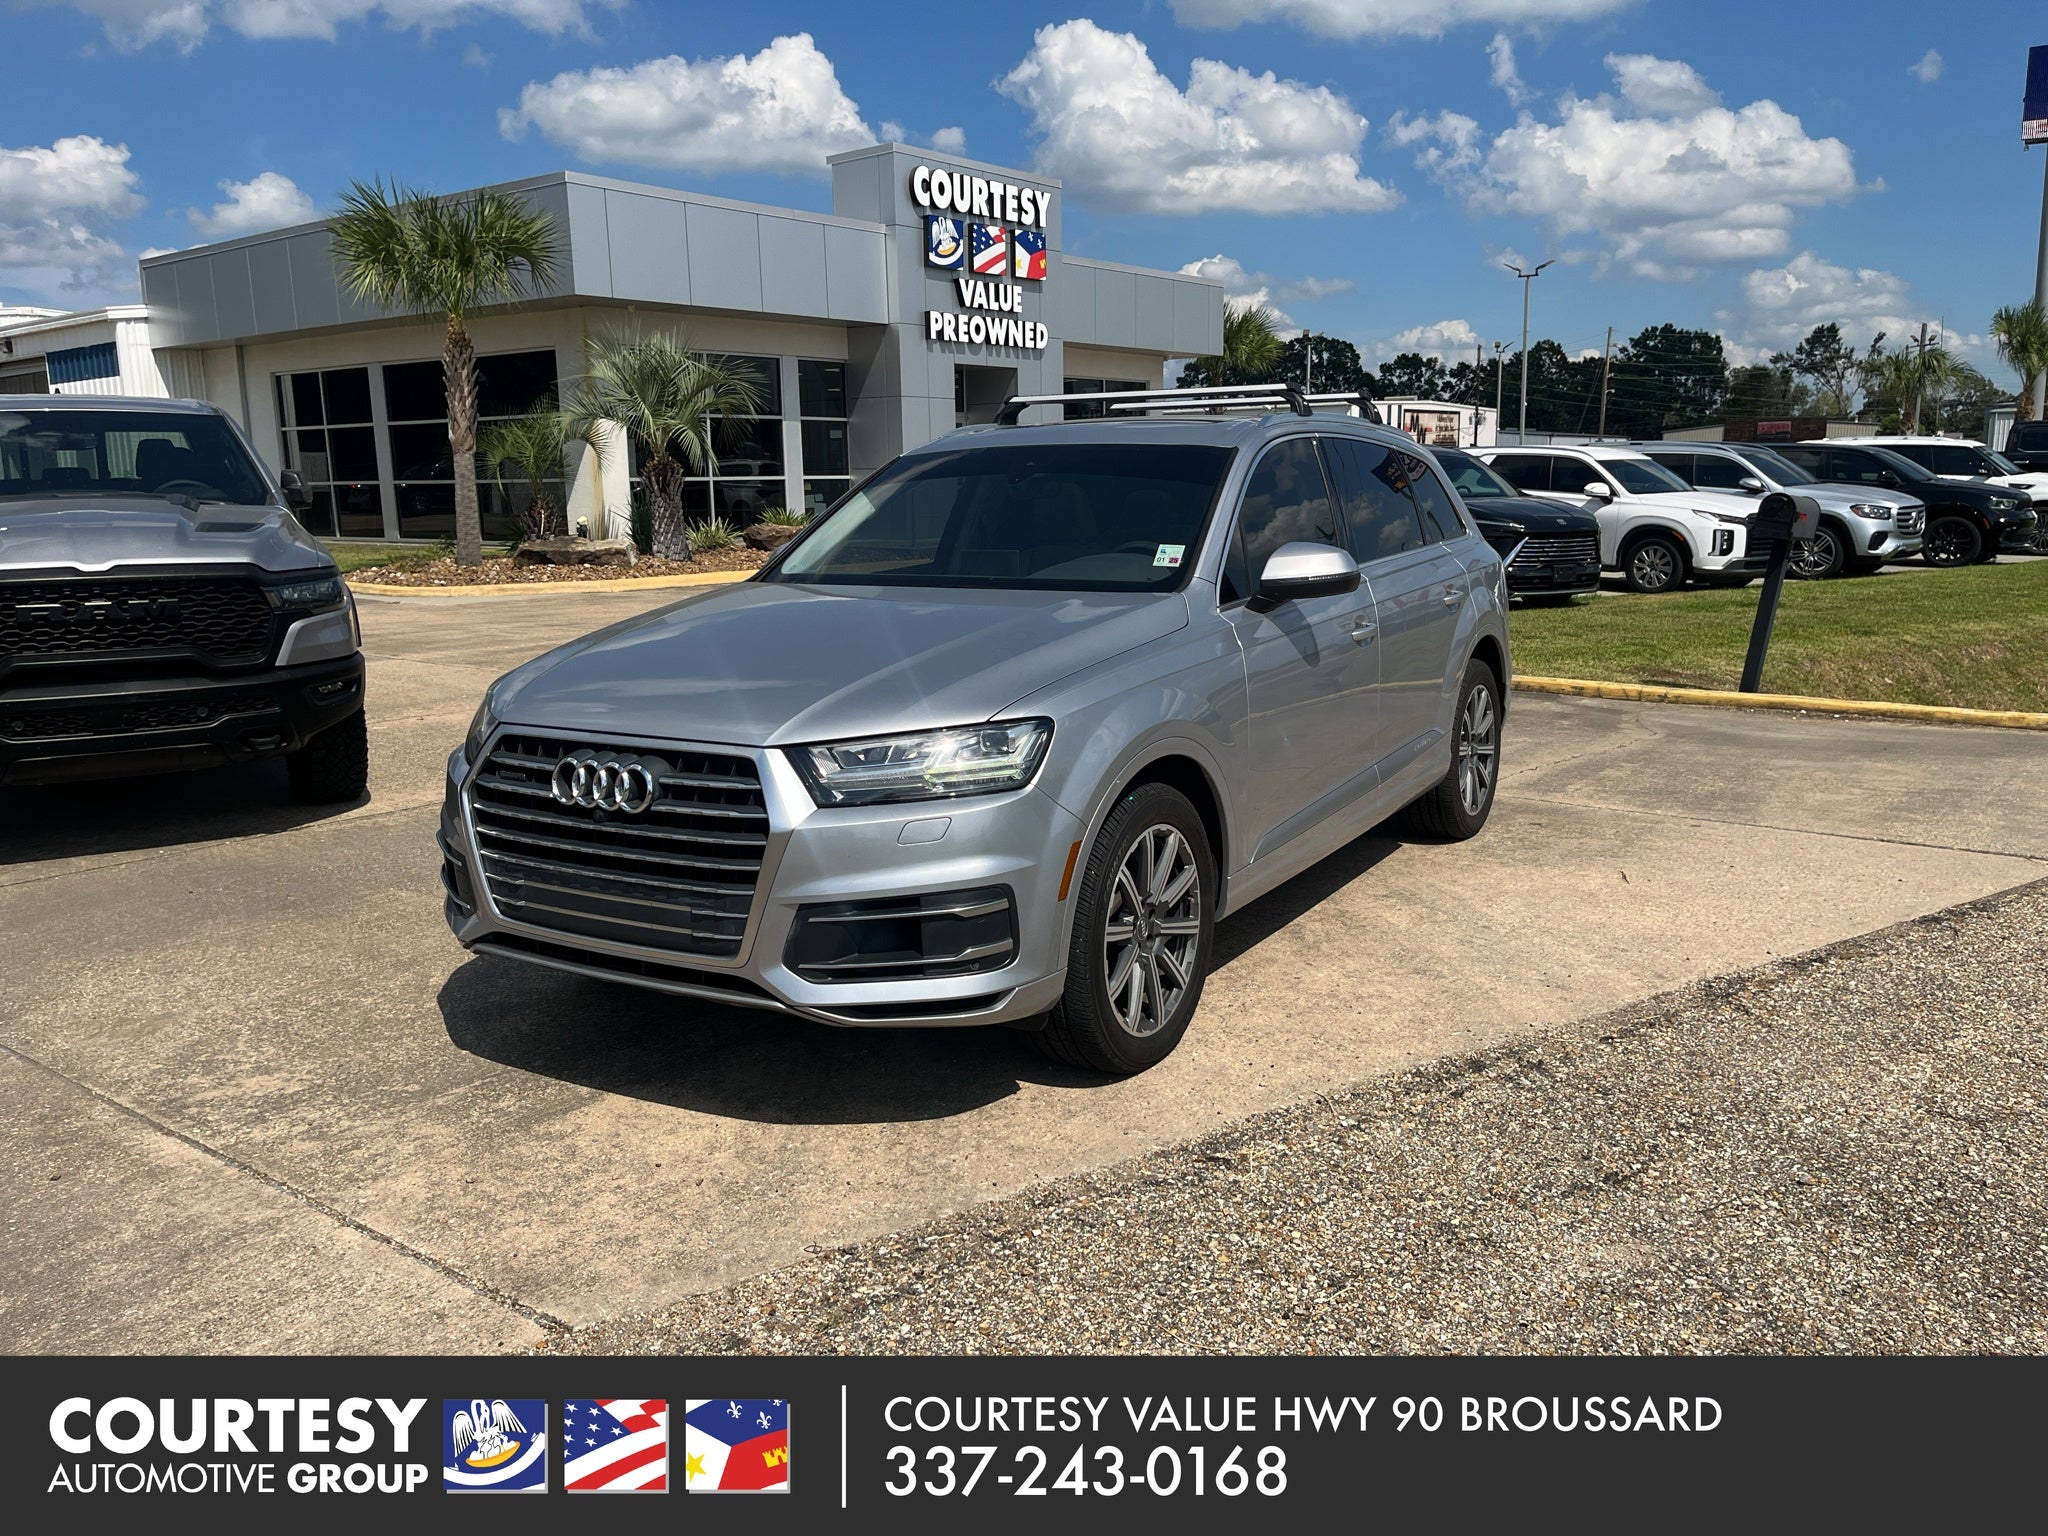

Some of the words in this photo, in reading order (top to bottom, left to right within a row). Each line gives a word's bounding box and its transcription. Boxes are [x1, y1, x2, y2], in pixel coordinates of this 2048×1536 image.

[913, 165, 1051, 228] COURTESY
[958, 278, 1023, 313] VALUE
[928, 311, 1049, 349] PREOWNED
[15, 597, 181, 623] RAM
